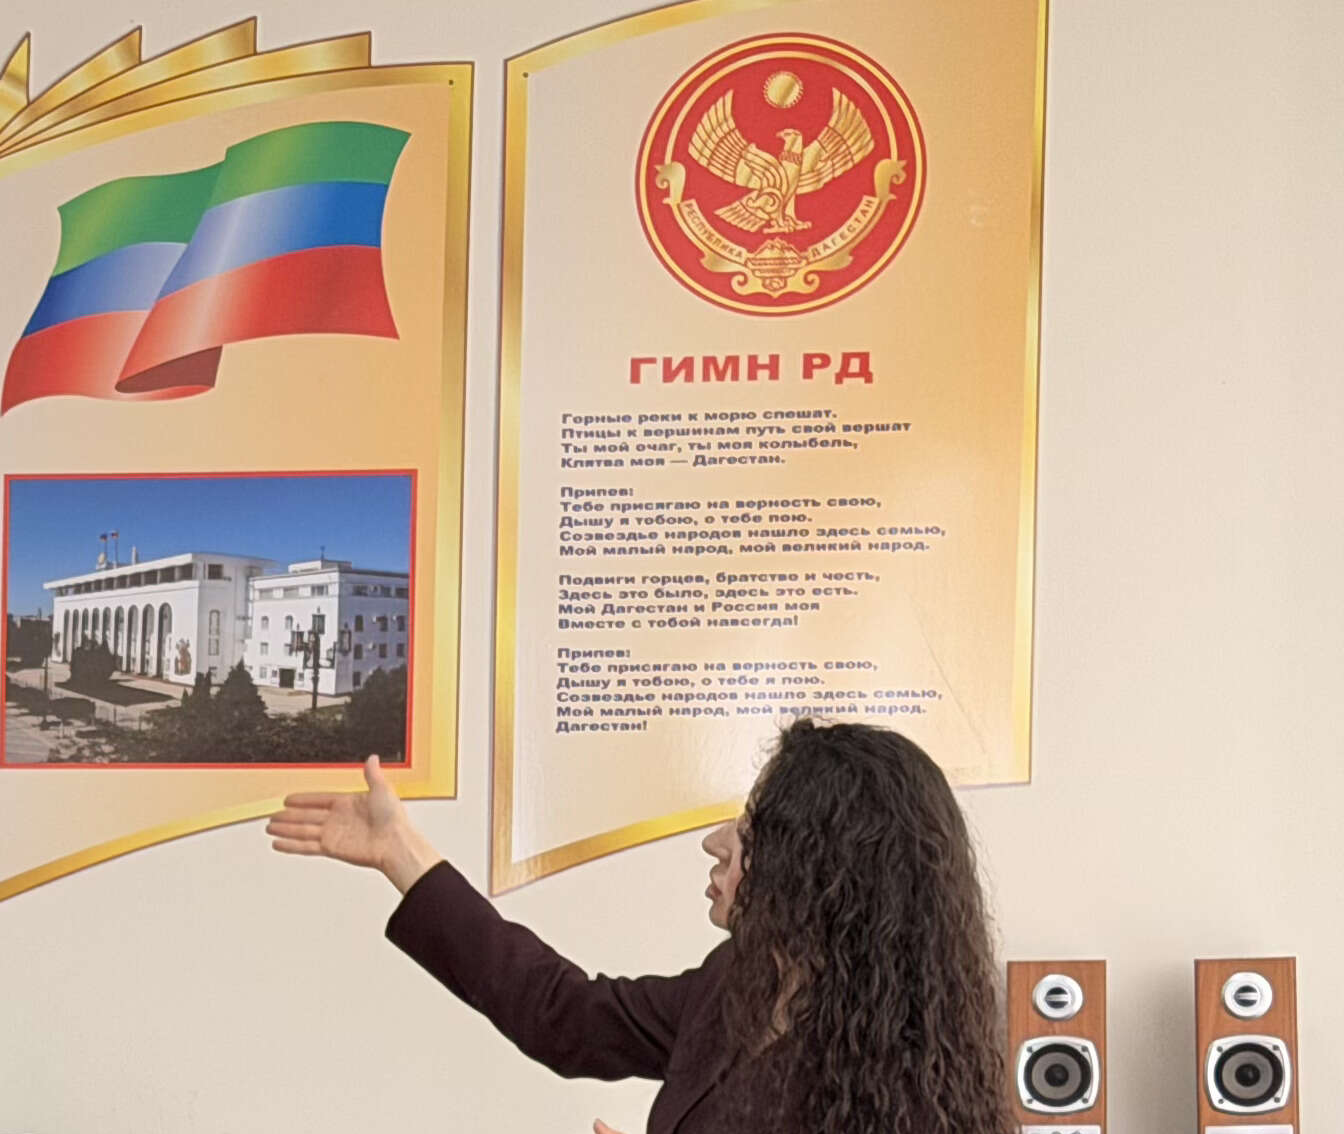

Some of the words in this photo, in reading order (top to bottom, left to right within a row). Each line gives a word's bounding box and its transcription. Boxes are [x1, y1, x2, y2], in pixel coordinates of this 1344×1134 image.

[681, 202, 744, 259] РЕСПУБЛИКА
[811, 199, 875, 258] ДАГЕСТАН
[629, 353, 780, 385] ГИМН
[802, 351, 874, 385] РД
